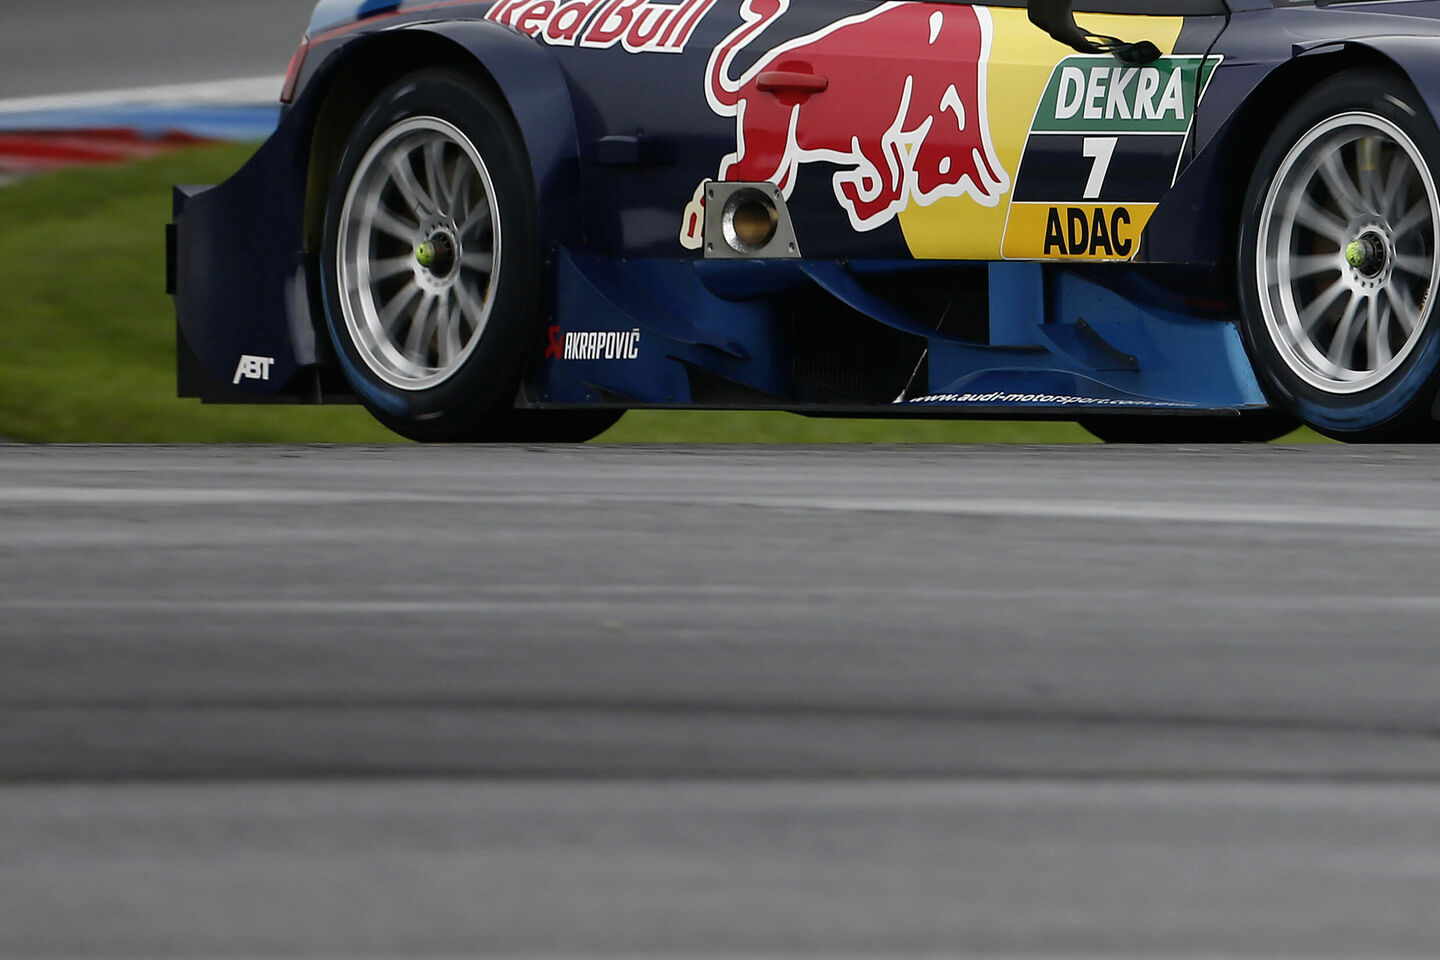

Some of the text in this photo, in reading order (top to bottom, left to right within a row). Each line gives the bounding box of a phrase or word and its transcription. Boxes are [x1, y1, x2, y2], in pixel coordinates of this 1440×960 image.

[1055, 66, 1185, 120] DEKRA
[1083, 137, 1118, 199] 7
[1043, 206, 1132, 257] ADAC
[232, 354, 275, 384] ABT
